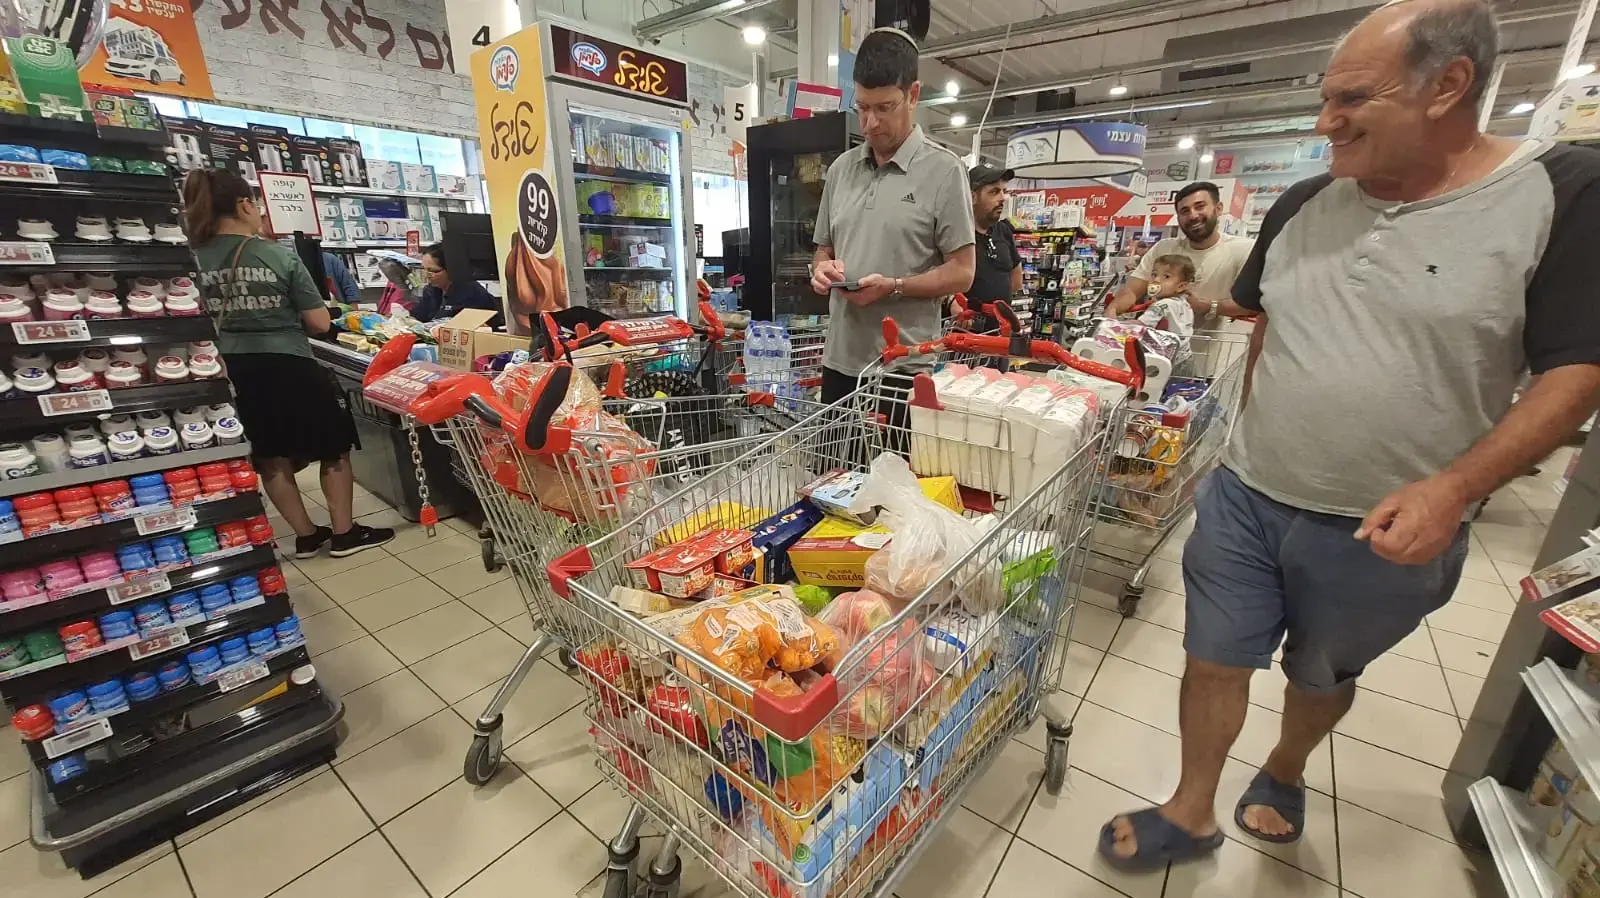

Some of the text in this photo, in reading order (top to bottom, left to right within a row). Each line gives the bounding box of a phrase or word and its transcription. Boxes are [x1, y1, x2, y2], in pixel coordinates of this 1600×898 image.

[471, 25, 491, 47] 4
[734, 102, 744, 121] 5
[1106, 130, 1132, 143] עצמי
[272, 180, 296, 189] קופה
[269, 191, 305, 200] לאשראי
[527, 182, 549, 220] 99
[278, 204, 304, 212] בלבד
[36, 326, 56, 338] 24
[61, 396, 79, 409] 24
[154, 517, 169, 527] 23
[127, 585, 142, 596] 23
[147, 640, 161, 651] 23
